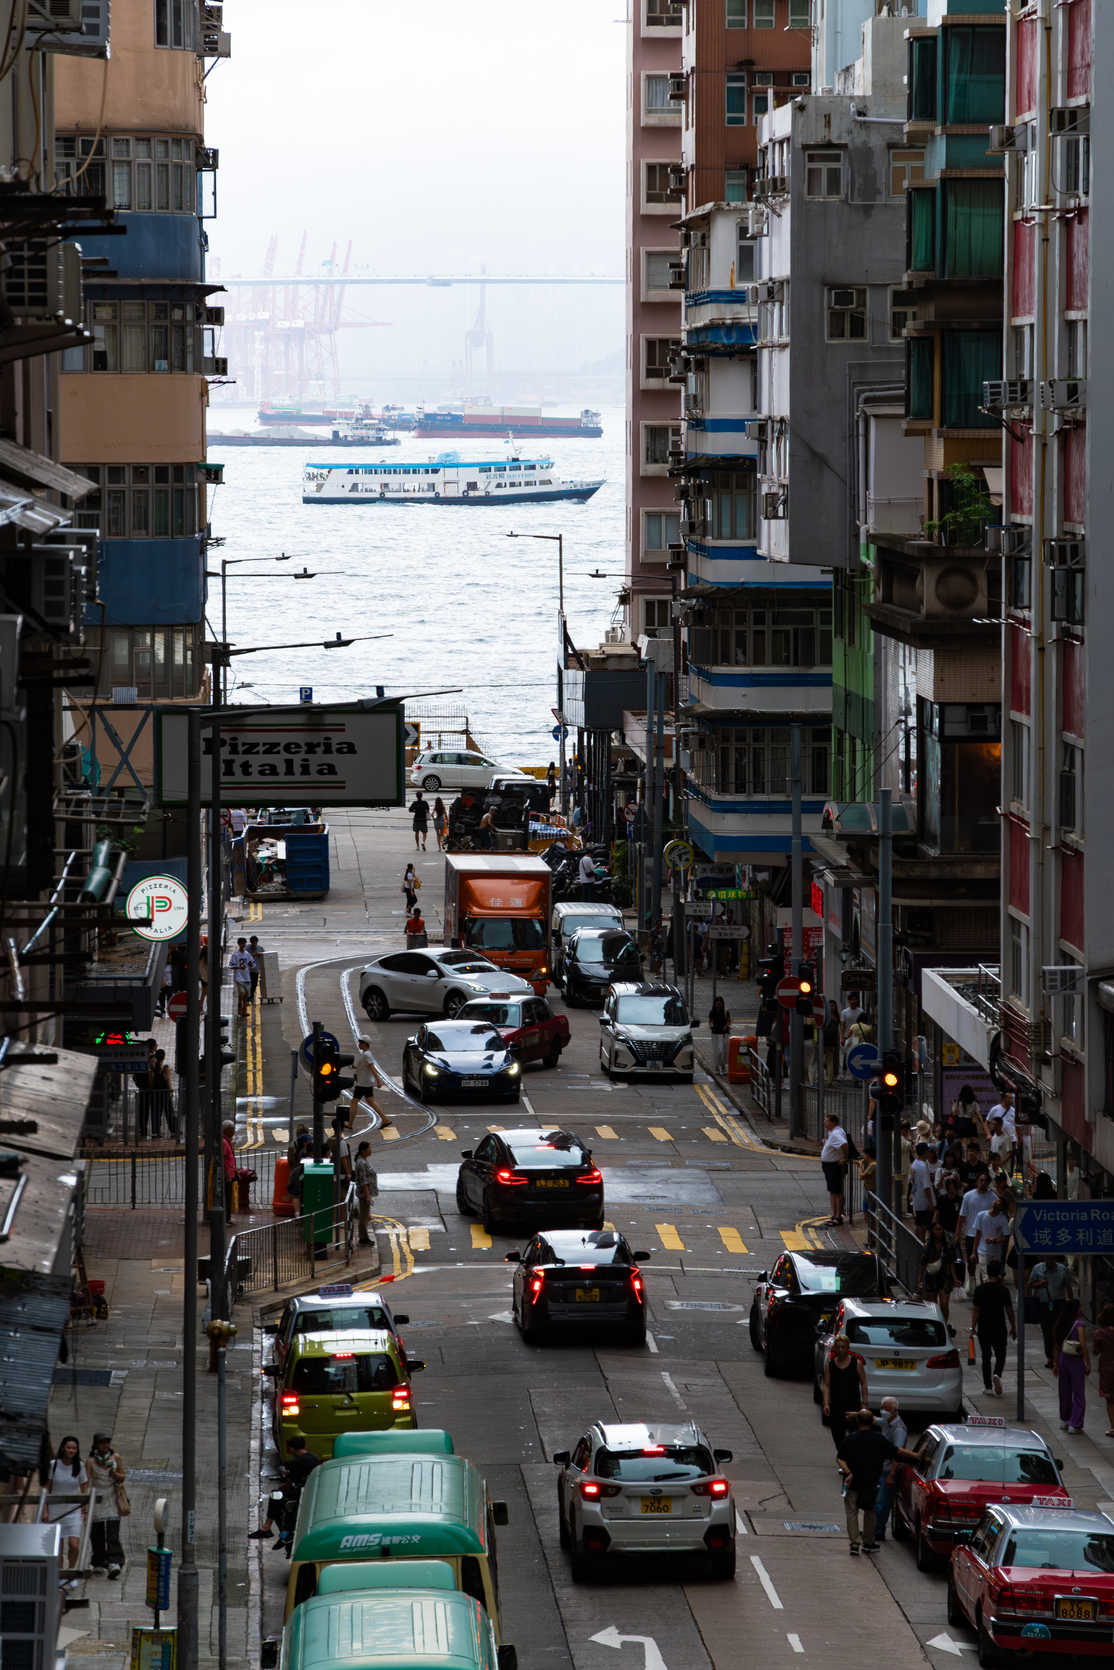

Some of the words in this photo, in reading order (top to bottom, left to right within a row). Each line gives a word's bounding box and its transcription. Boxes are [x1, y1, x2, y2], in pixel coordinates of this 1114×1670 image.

[202, 736, 357, 755] Pizzeria
[222, 758, 338, 777] Italia
[1032, 1208, 1088, 1222] Victoria
[1032, 1228, 1114, 1247] 域多利道
[1037, 1497, 1072, 1507] TAXI
[339, 1532, 382, 1548] AMS
